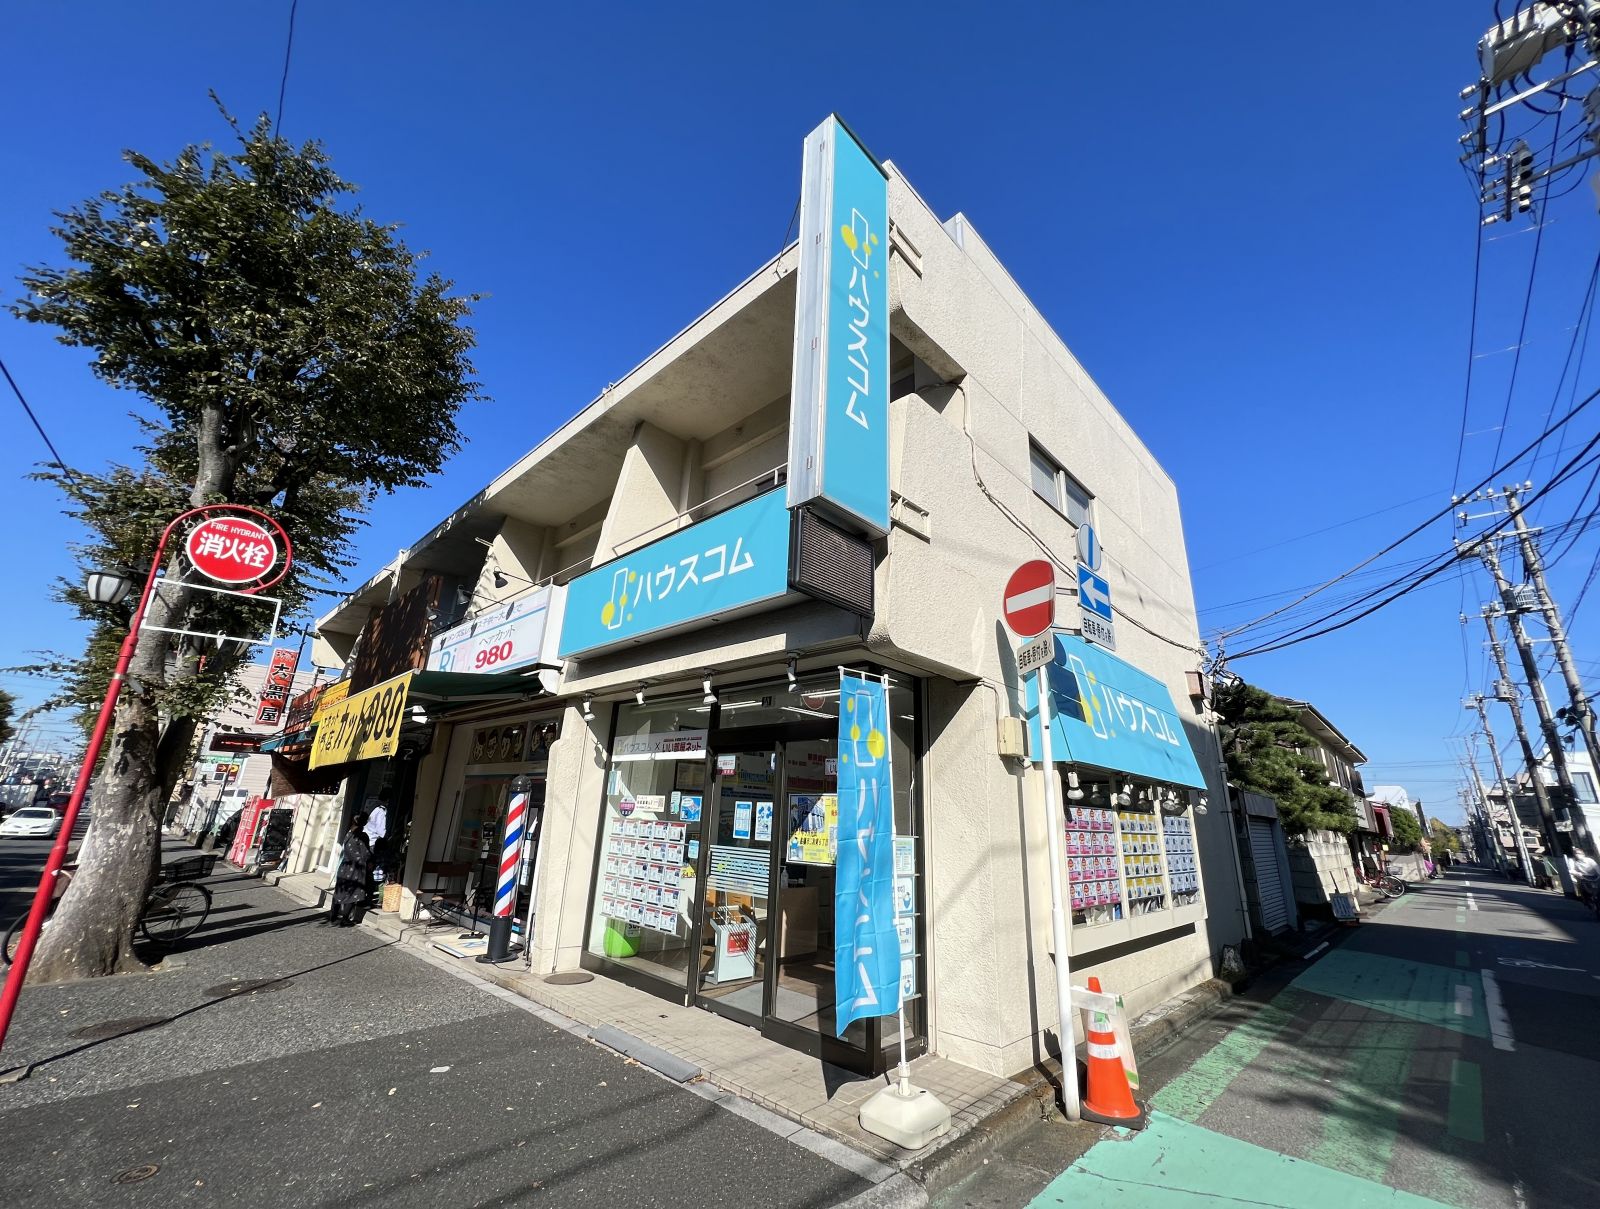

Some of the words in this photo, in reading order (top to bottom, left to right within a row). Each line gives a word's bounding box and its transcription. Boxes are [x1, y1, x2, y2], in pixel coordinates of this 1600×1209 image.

[845, 266, 870, 430] ハウスコム
[194, 531, 270, 568] 消火栓
[210, 522, 229, 532] FIRE
[230, 526, 266, 540] HYDRANT
[633, 536, 755, 609] ハウスコム
[474, 640, 514, 670] 980
[258, 663, 291, 722] 大黒屋
[362, 682, 405, 743] 980
[1101, 684, 1181, 747] ハウスコム
